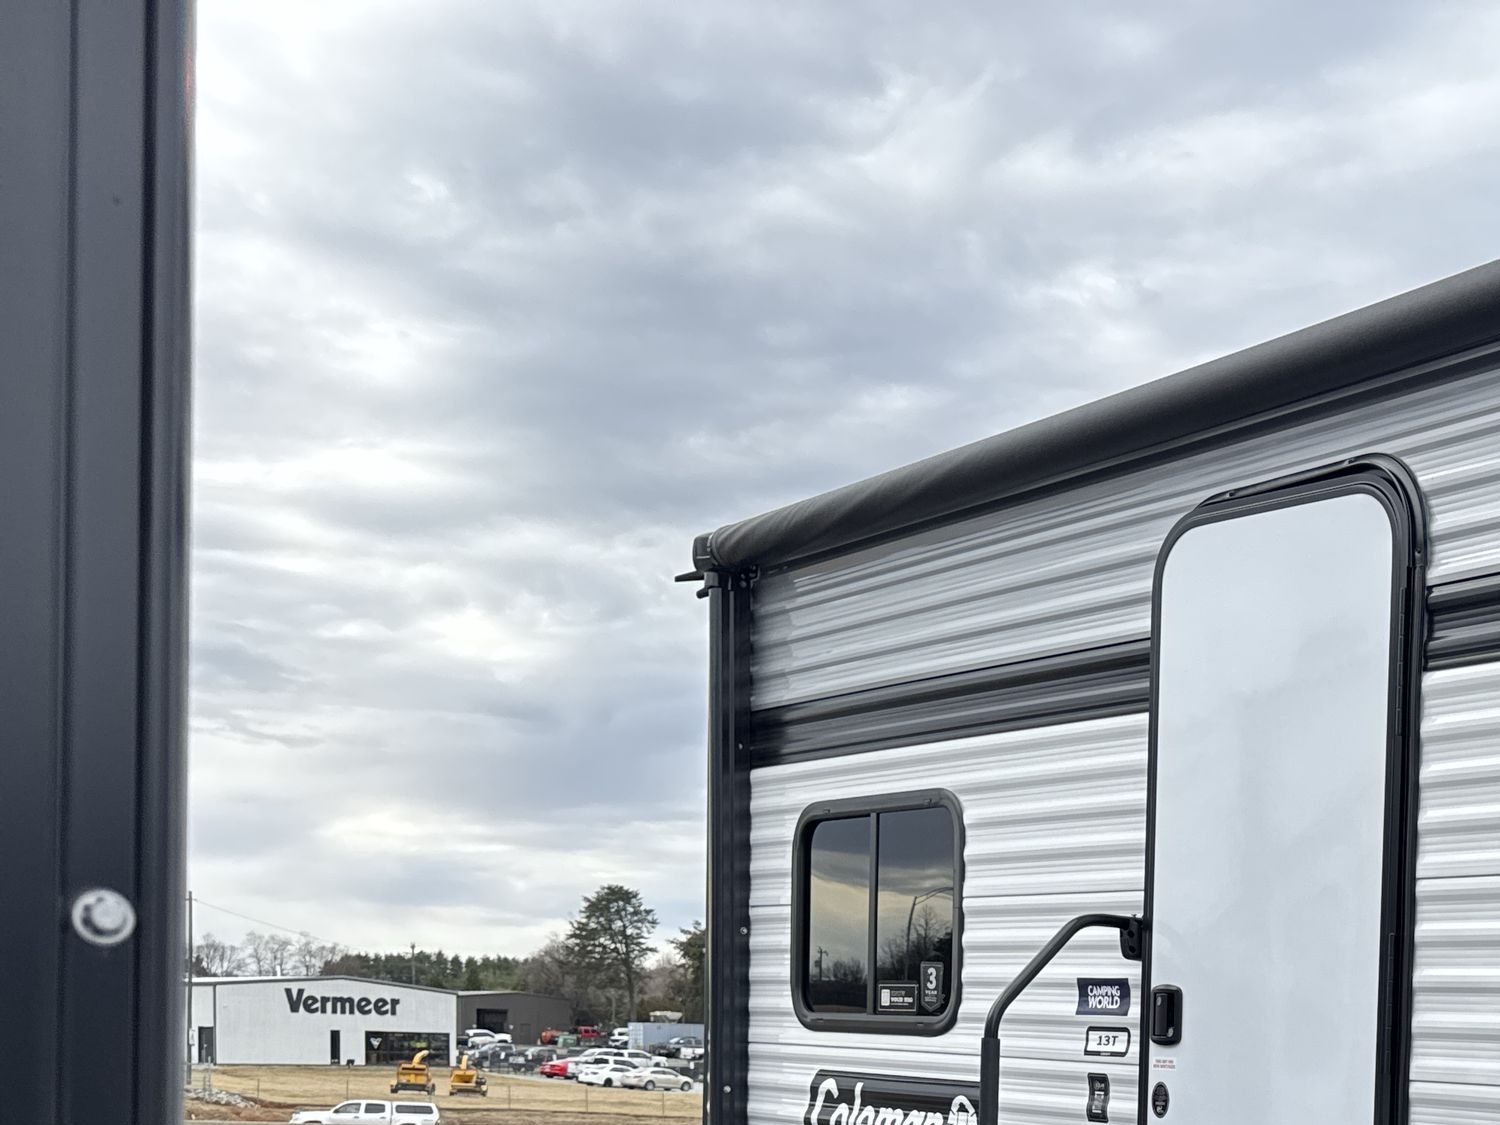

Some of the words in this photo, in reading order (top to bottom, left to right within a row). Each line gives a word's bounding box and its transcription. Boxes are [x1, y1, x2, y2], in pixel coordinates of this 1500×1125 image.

[926, 967, 937, 989] 3
[1087, 985, 1120, 996] CAMPING
[284, 988, 400, 1016] Vermeer
[1088, 996, 1121, 1009] WORLD
[1096, 1035, 1119, 1046] 13T
